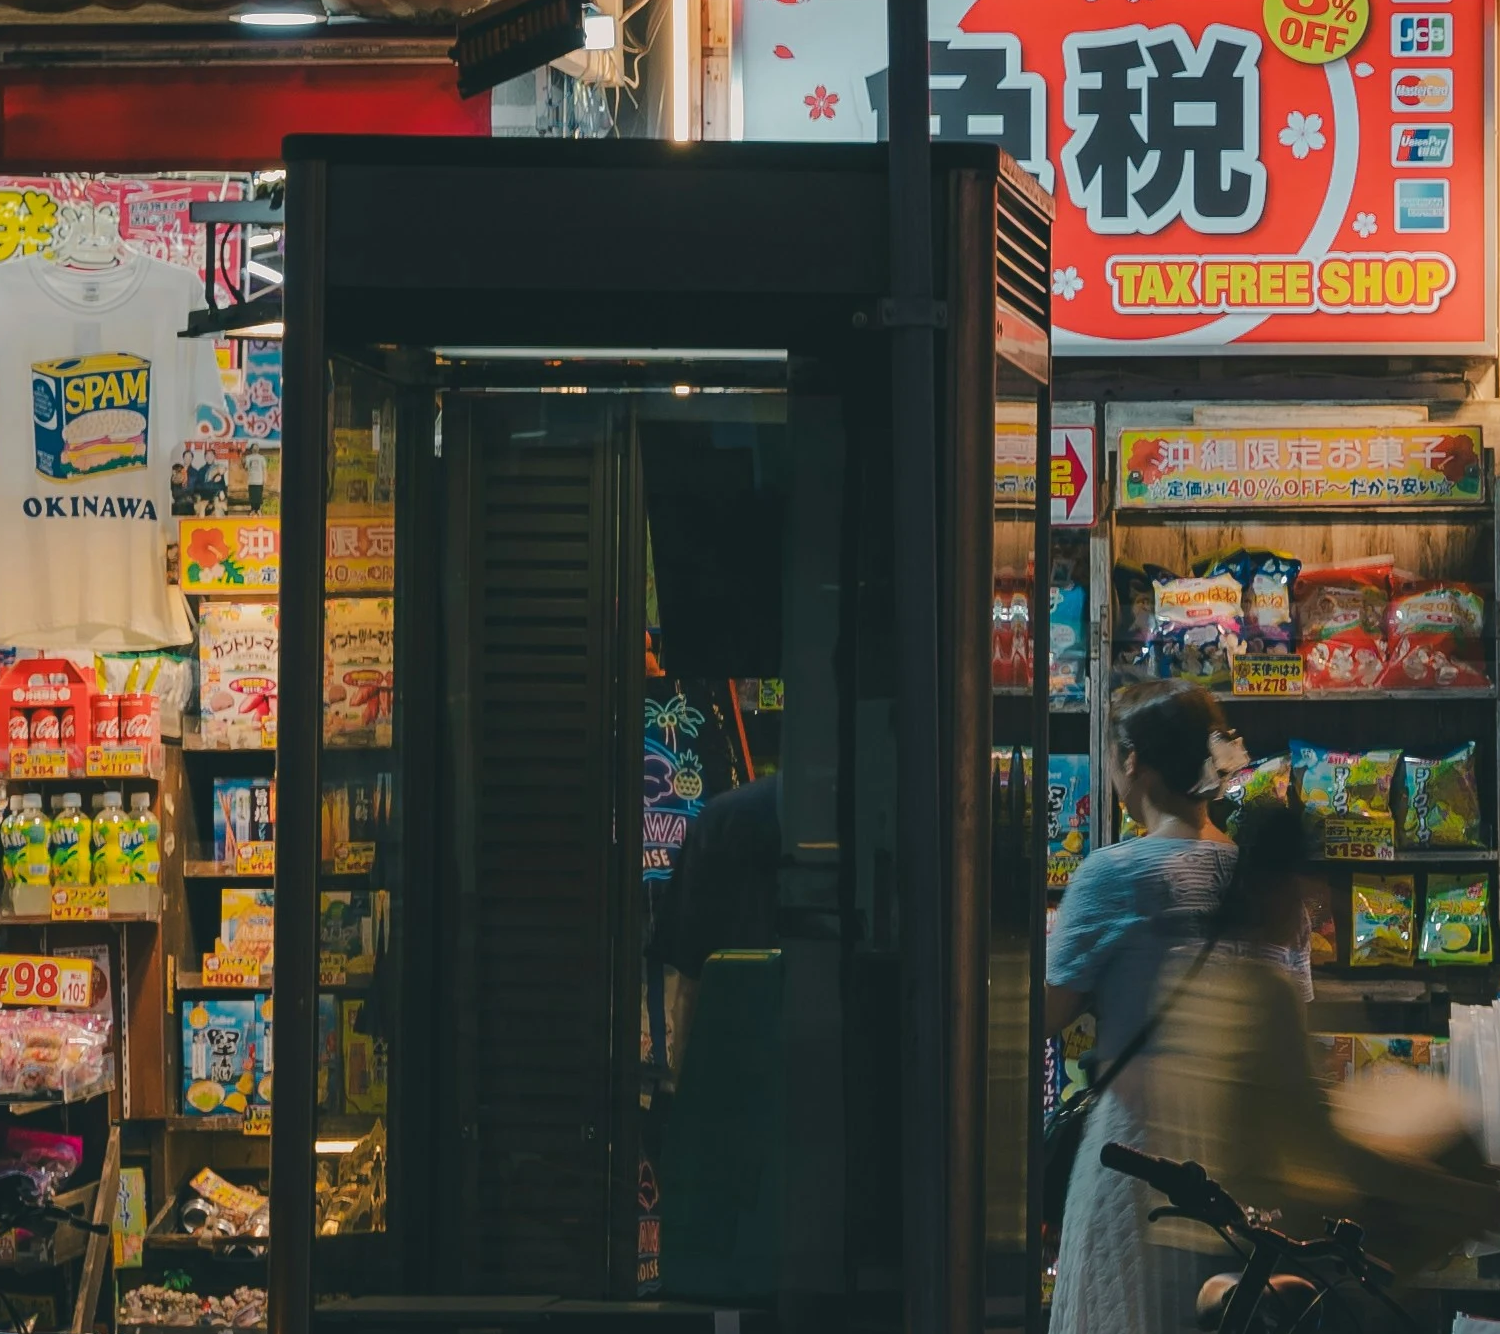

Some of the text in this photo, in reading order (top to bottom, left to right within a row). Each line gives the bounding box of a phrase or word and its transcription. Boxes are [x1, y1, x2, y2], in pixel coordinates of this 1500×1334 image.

[1278, 17, 1349, 56] OFF
[1397, 17, 1446, 53] JCB
[1115, 260, 1446, 305] TAX FREE SHOP
[64, 371, 148, 415] SPAM
[1157, 436, 1448, 472] 沖縄限定お菓子
[22, 496, 158, 521] OKINAWA
[238, 527, 275, 560] 沖
[1326, 843, 1376, 858] ¥158
